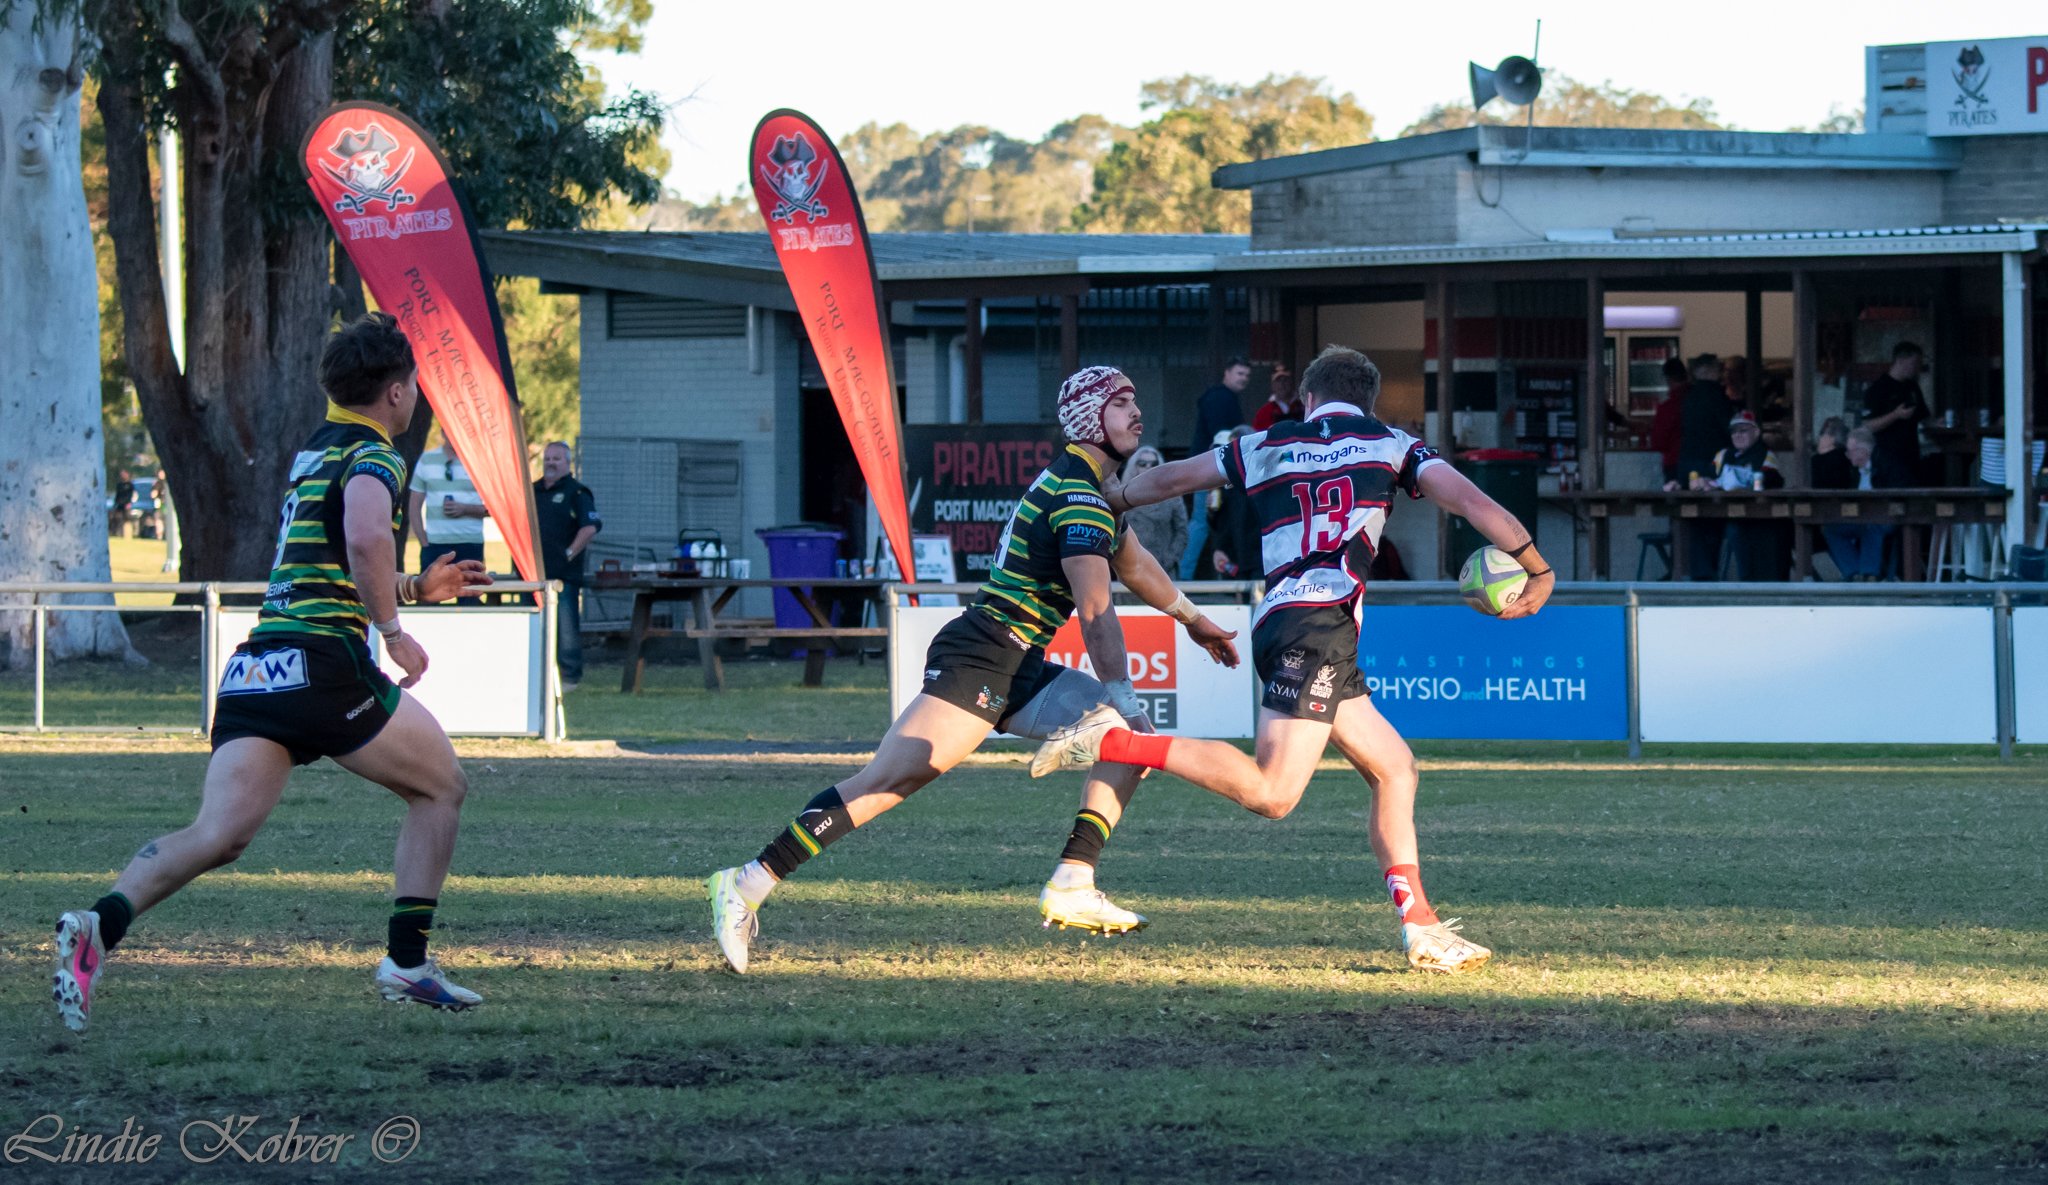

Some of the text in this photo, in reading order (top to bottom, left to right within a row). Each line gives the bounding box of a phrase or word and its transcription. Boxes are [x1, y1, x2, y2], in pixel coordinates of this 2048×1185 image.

[1948, 110, 1997, 127] PIRATES
[343, 208, 453, 240] PIRATES
[777, 223, 854, 252] PIRATES
[404, 266, 439, 317] PORT
[819, 281, 846, 331] PORT
[933, 441, 1053, 486] PIRATES
[1296, 445, 1367, 464] morgans
[934, 501, 970, 521] PORT
[1291, 475, 1355, 560] 13
[967, 554, 993, 570] SINC
[1365, 655, 1585, 668] HASTINGS
[1268, 681, 1299, 699] RYAN
[1366, 677, 1585, 701] PHYSIO and HEALTH
[813, 816, 833, 836] 2XU
